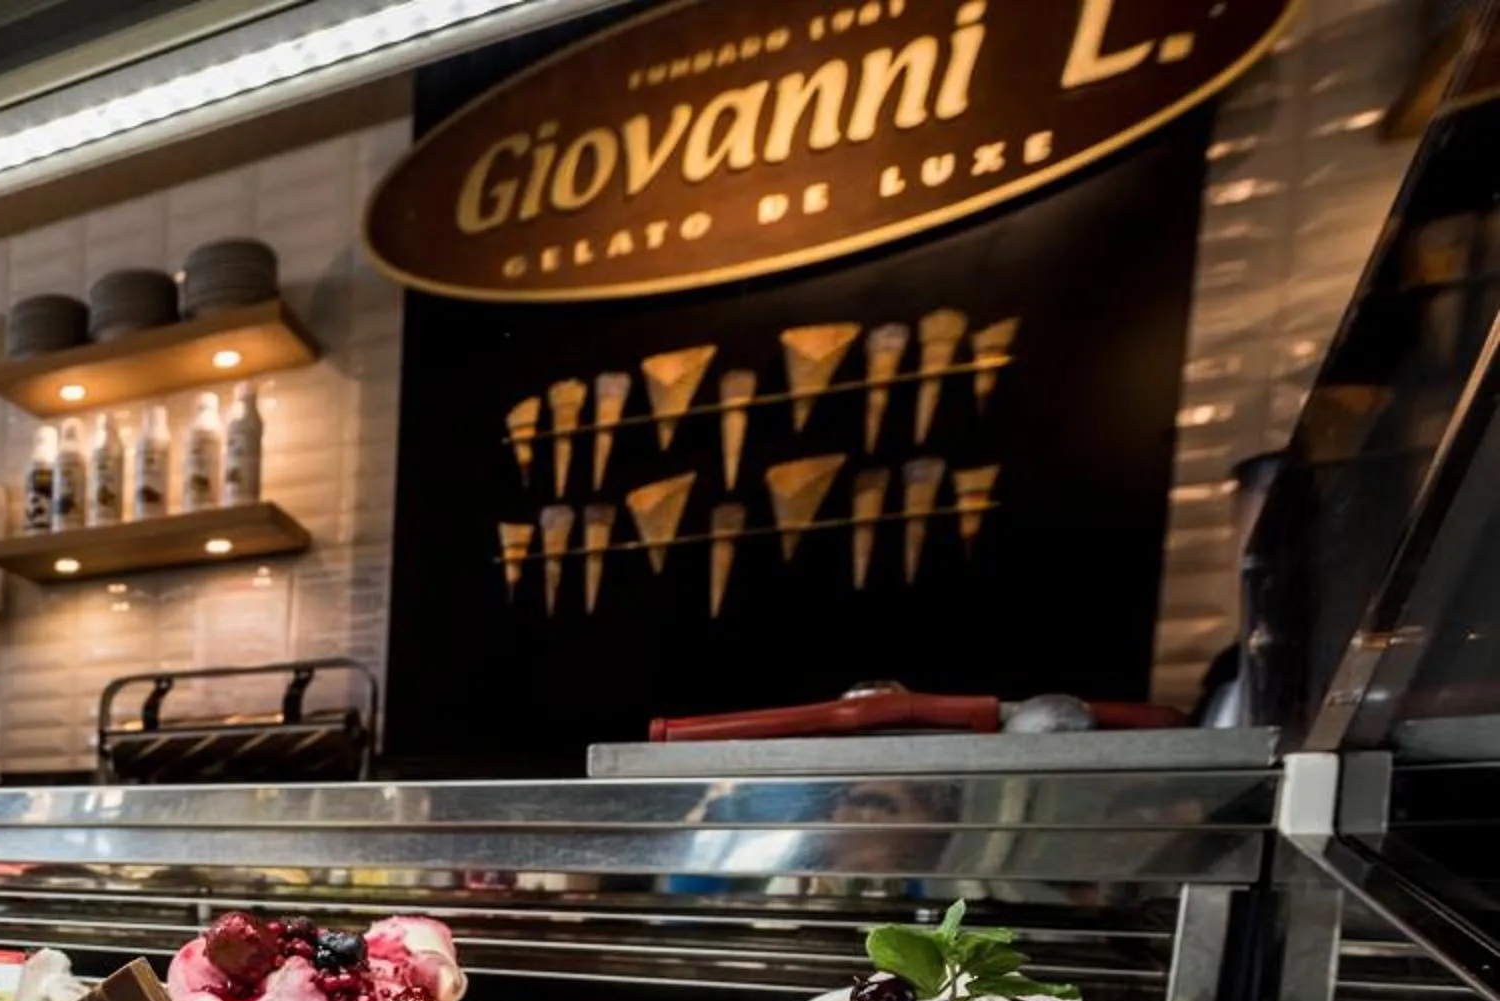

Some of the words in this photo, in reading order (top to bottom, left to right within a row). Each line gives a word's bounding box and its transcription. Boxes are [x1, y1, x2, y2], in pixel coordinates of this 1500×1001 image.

[453, 0, 988, 236] Giovanni
[1061, 0, 1195, 89] L.
[502, 210, 713, 278] GELATO
[757, 182, 829, 224] DE
[879, 130, 1053, 198] LUXE
